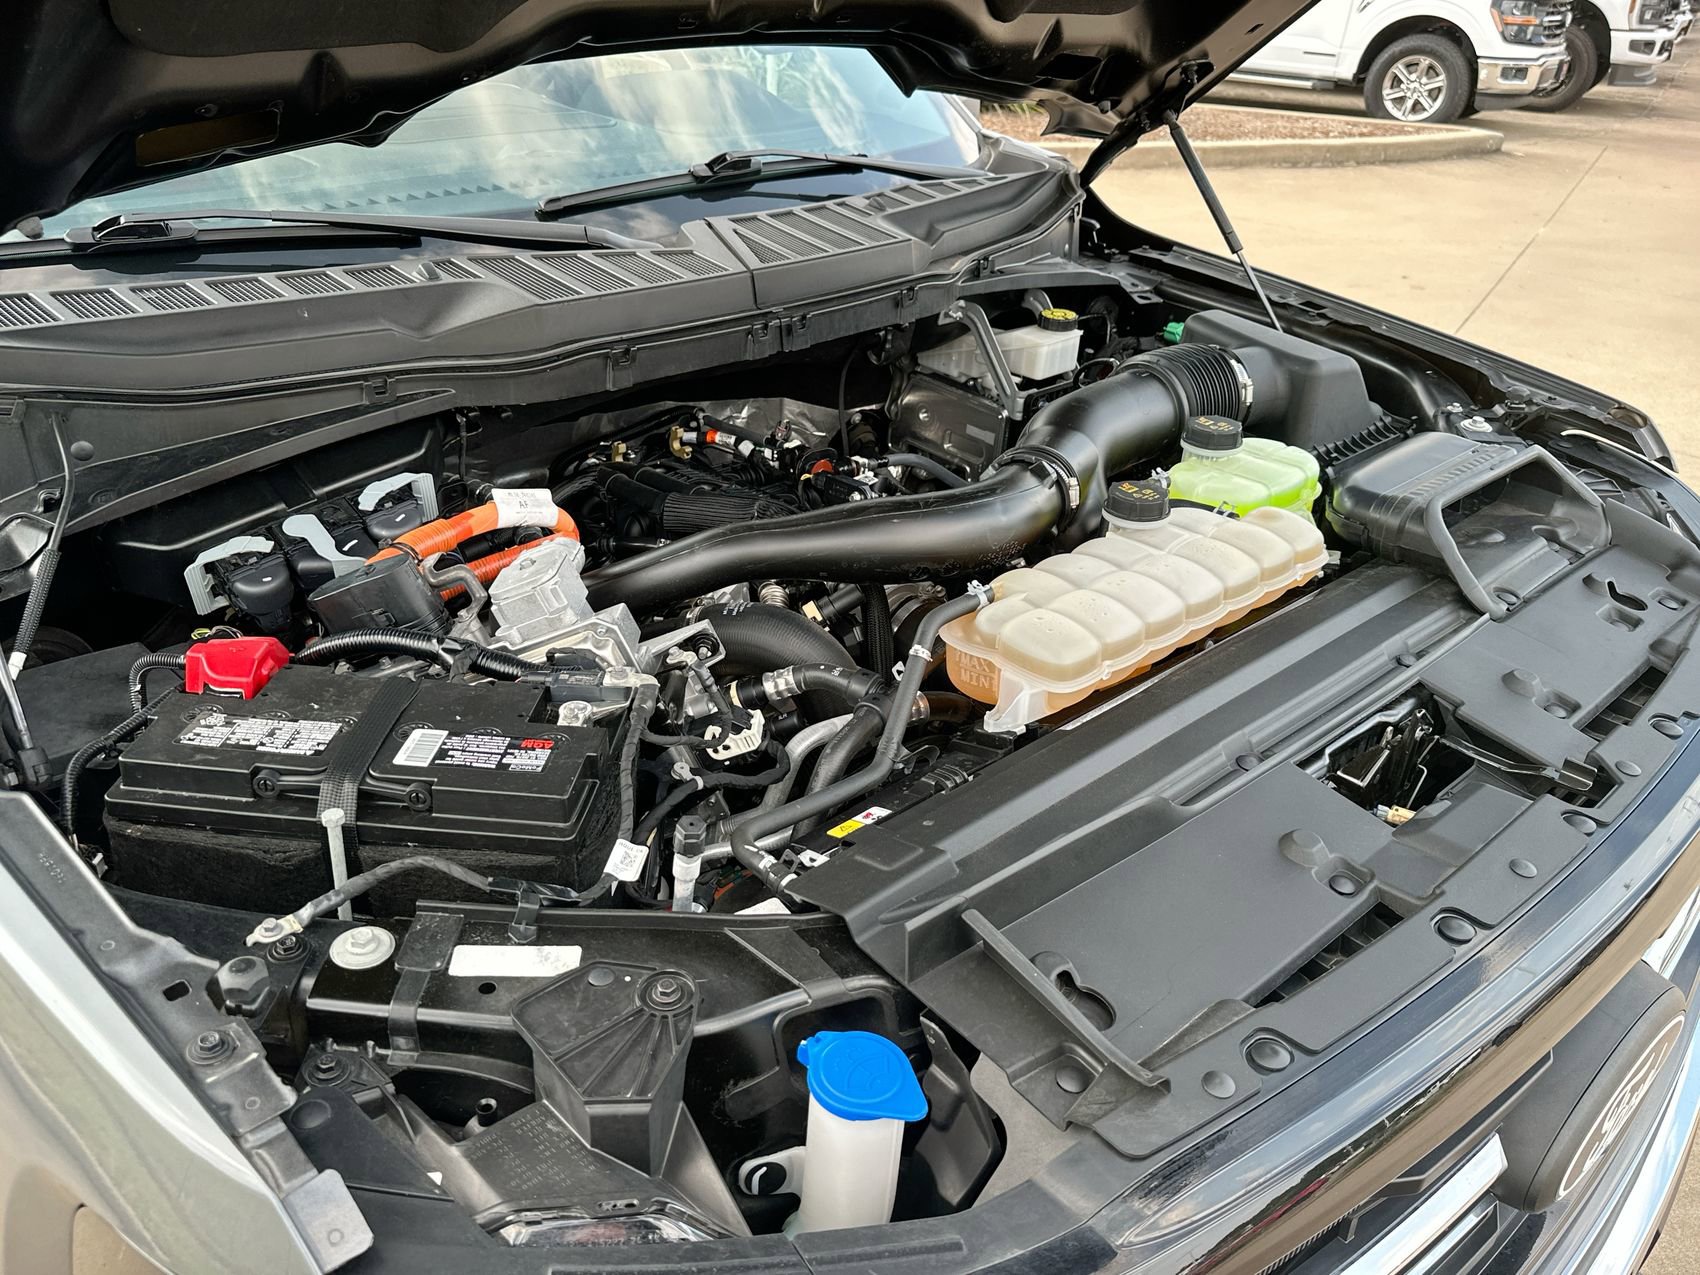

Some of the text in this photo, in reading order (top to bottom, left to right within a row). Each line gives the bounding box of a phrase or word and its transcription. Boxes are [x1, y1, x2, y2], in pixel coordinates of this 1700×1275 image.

[960, 653, 990, 673] MAX
[960, 669, 990, 688] MIN
[521, 739, 554, 749] AGM
